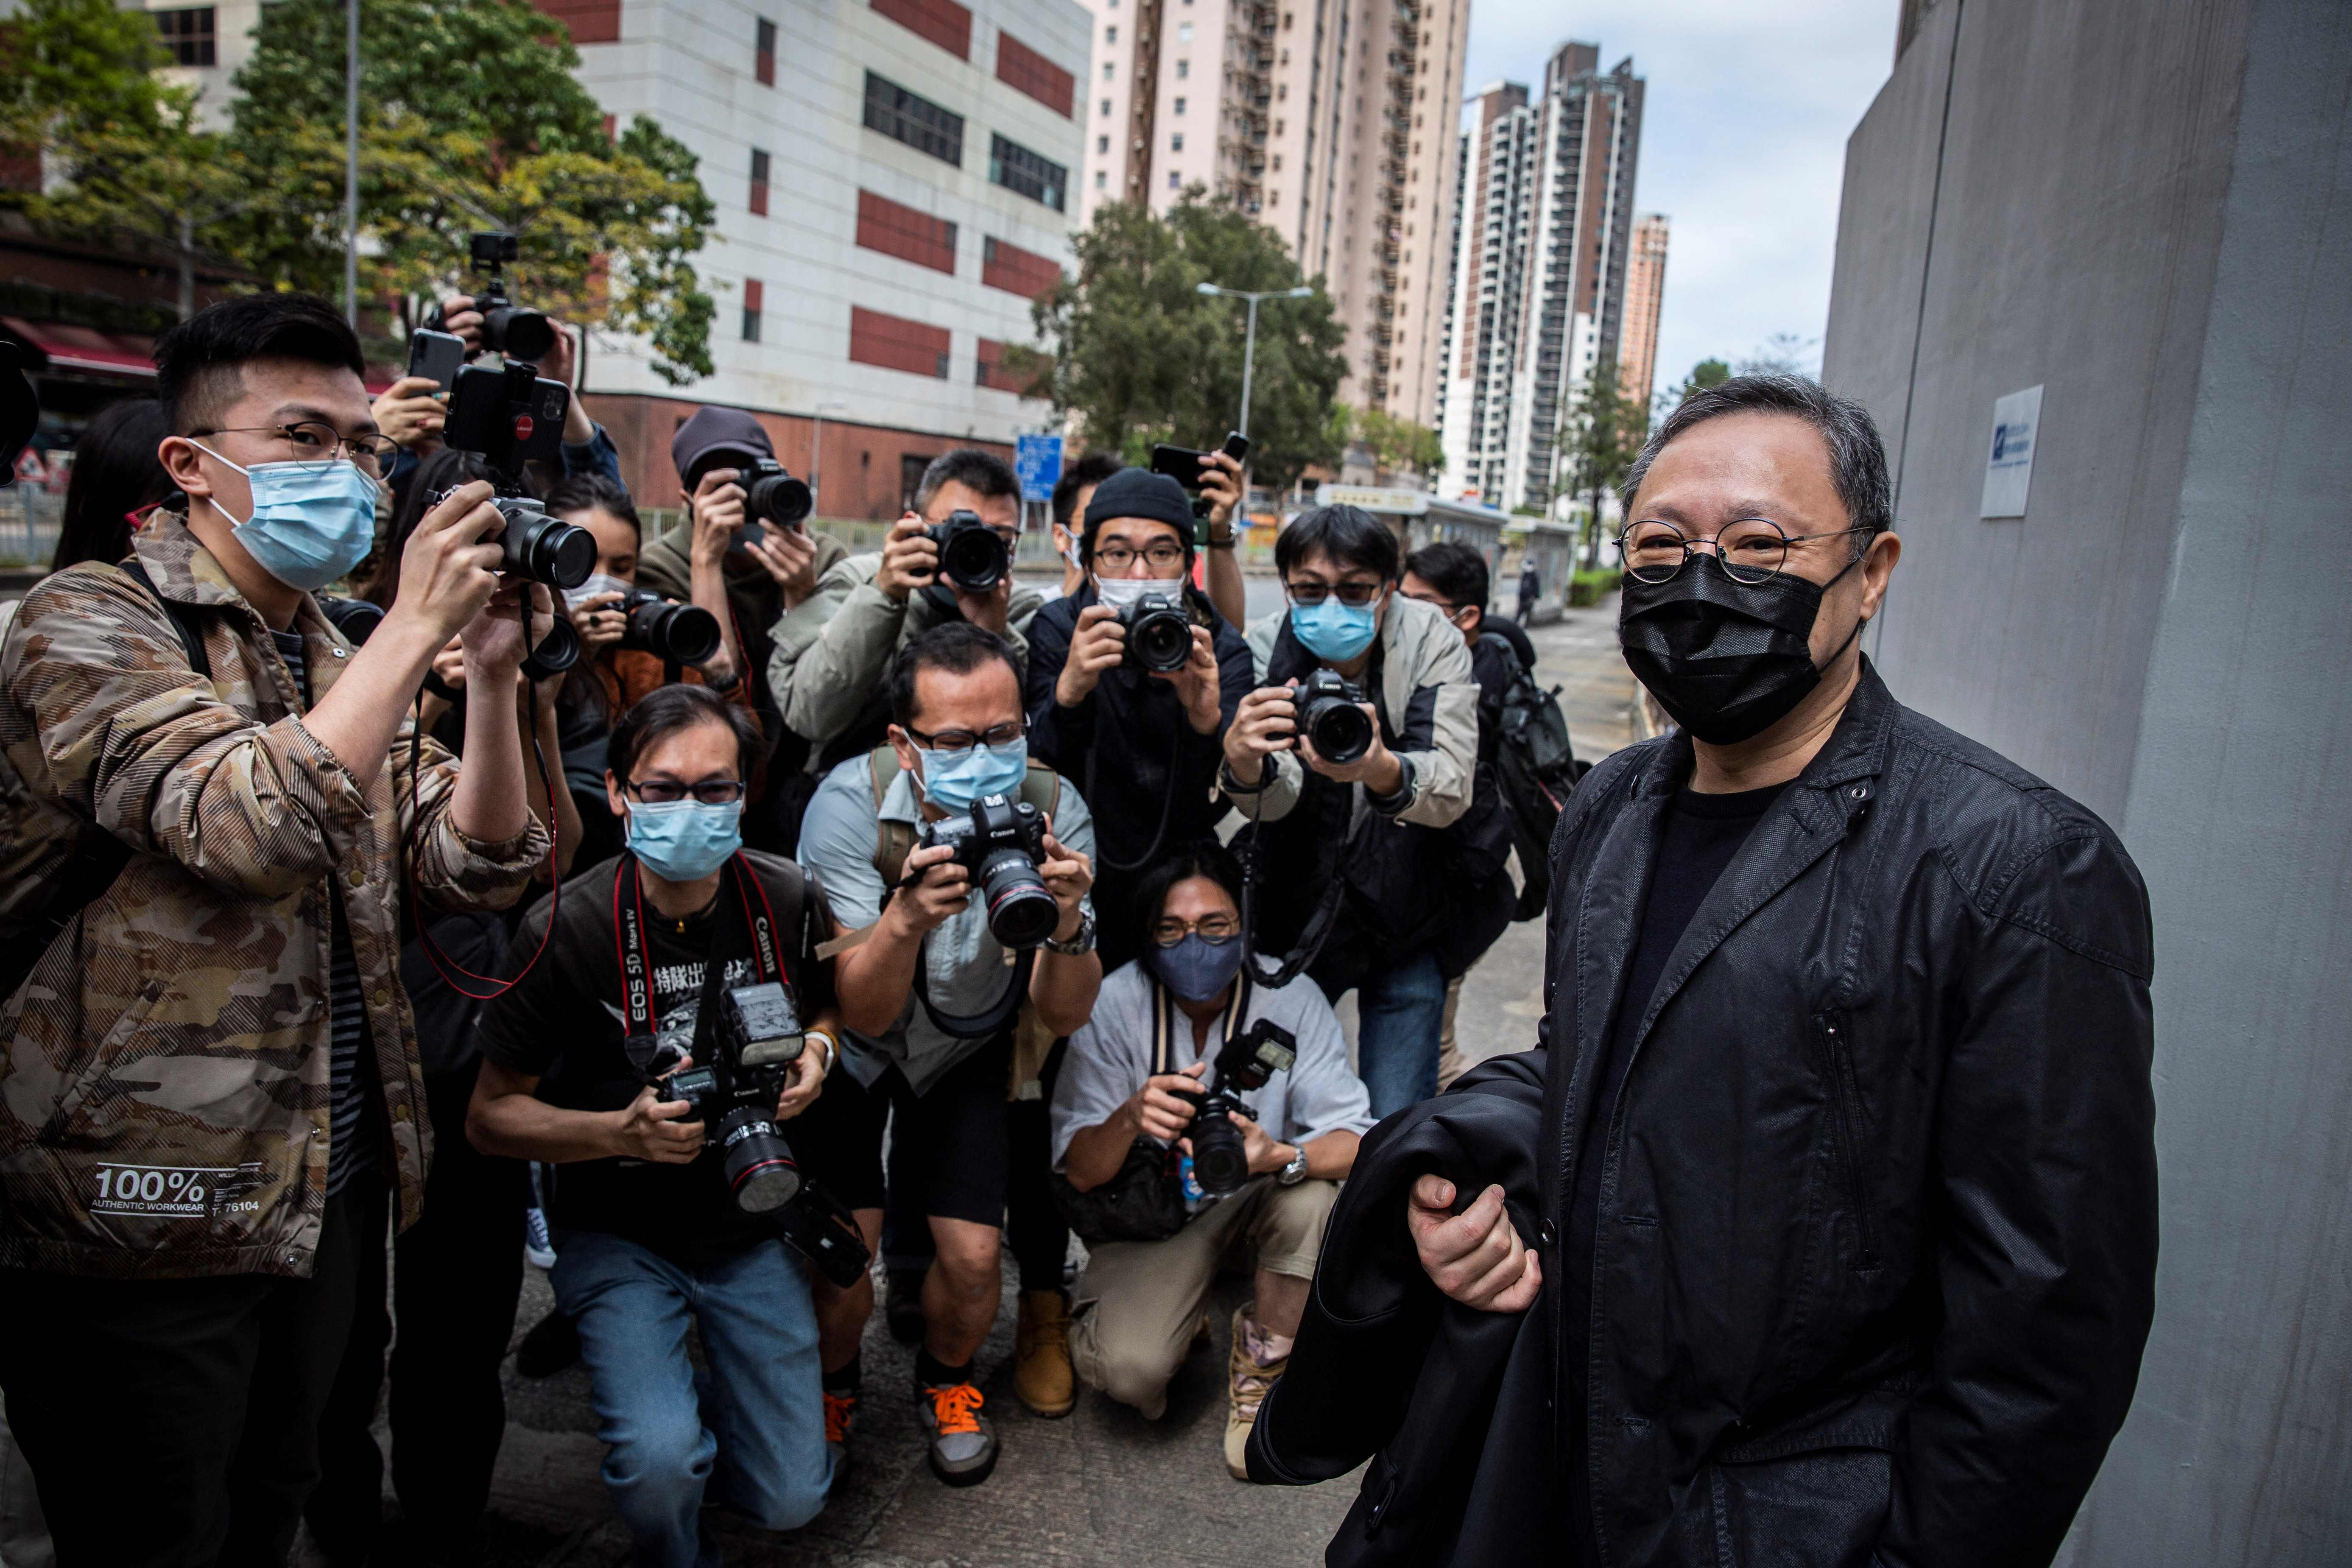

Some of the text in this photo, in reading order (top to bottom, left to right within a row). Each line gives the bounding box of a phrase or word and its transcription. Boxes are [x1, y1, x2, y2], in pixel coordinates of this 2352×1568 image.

[1145, 601, 1168, 610] Canon
[1319, 682, 1341, 690] Canon
[989, 828, 1016, 839] Canon
[756, 916, 776, 974] Canon
[626, 953, 642, 974] 5D
[629, 978, 647, 1021] EOS
[733, 1088, 760, 1098] Canon
[96, 1168, 205, 1202] 100%
[92, 1199, 204, 1211] AUTHENTIC WORKWEAR
[224, 1201, 260, 1213] 76104
